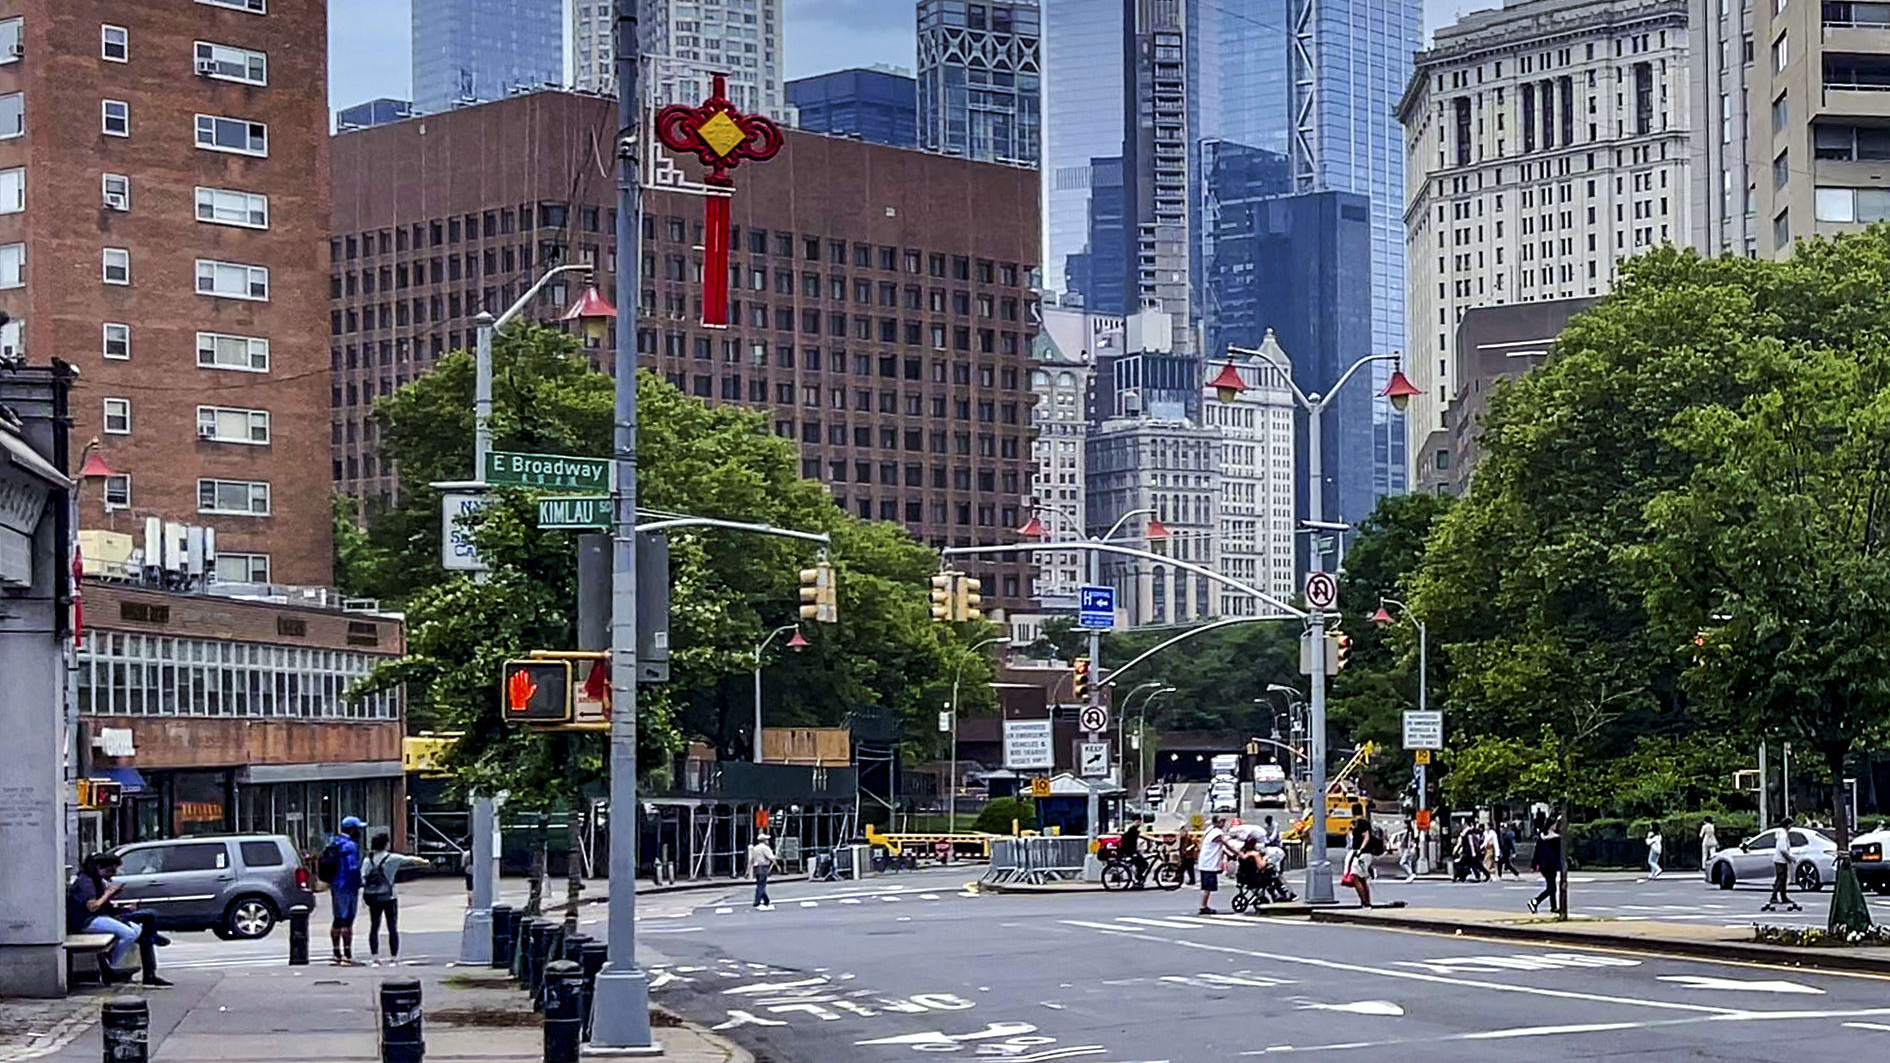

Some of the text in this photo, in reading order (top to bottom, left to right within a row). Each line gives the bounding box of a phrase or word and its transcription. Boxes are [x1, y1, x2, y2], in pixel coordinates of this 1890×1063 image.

[493, 455, 505, 472] E
[511, 456, 603, 482] Broadway
[540, 500, 593, 524] KIMLAU
